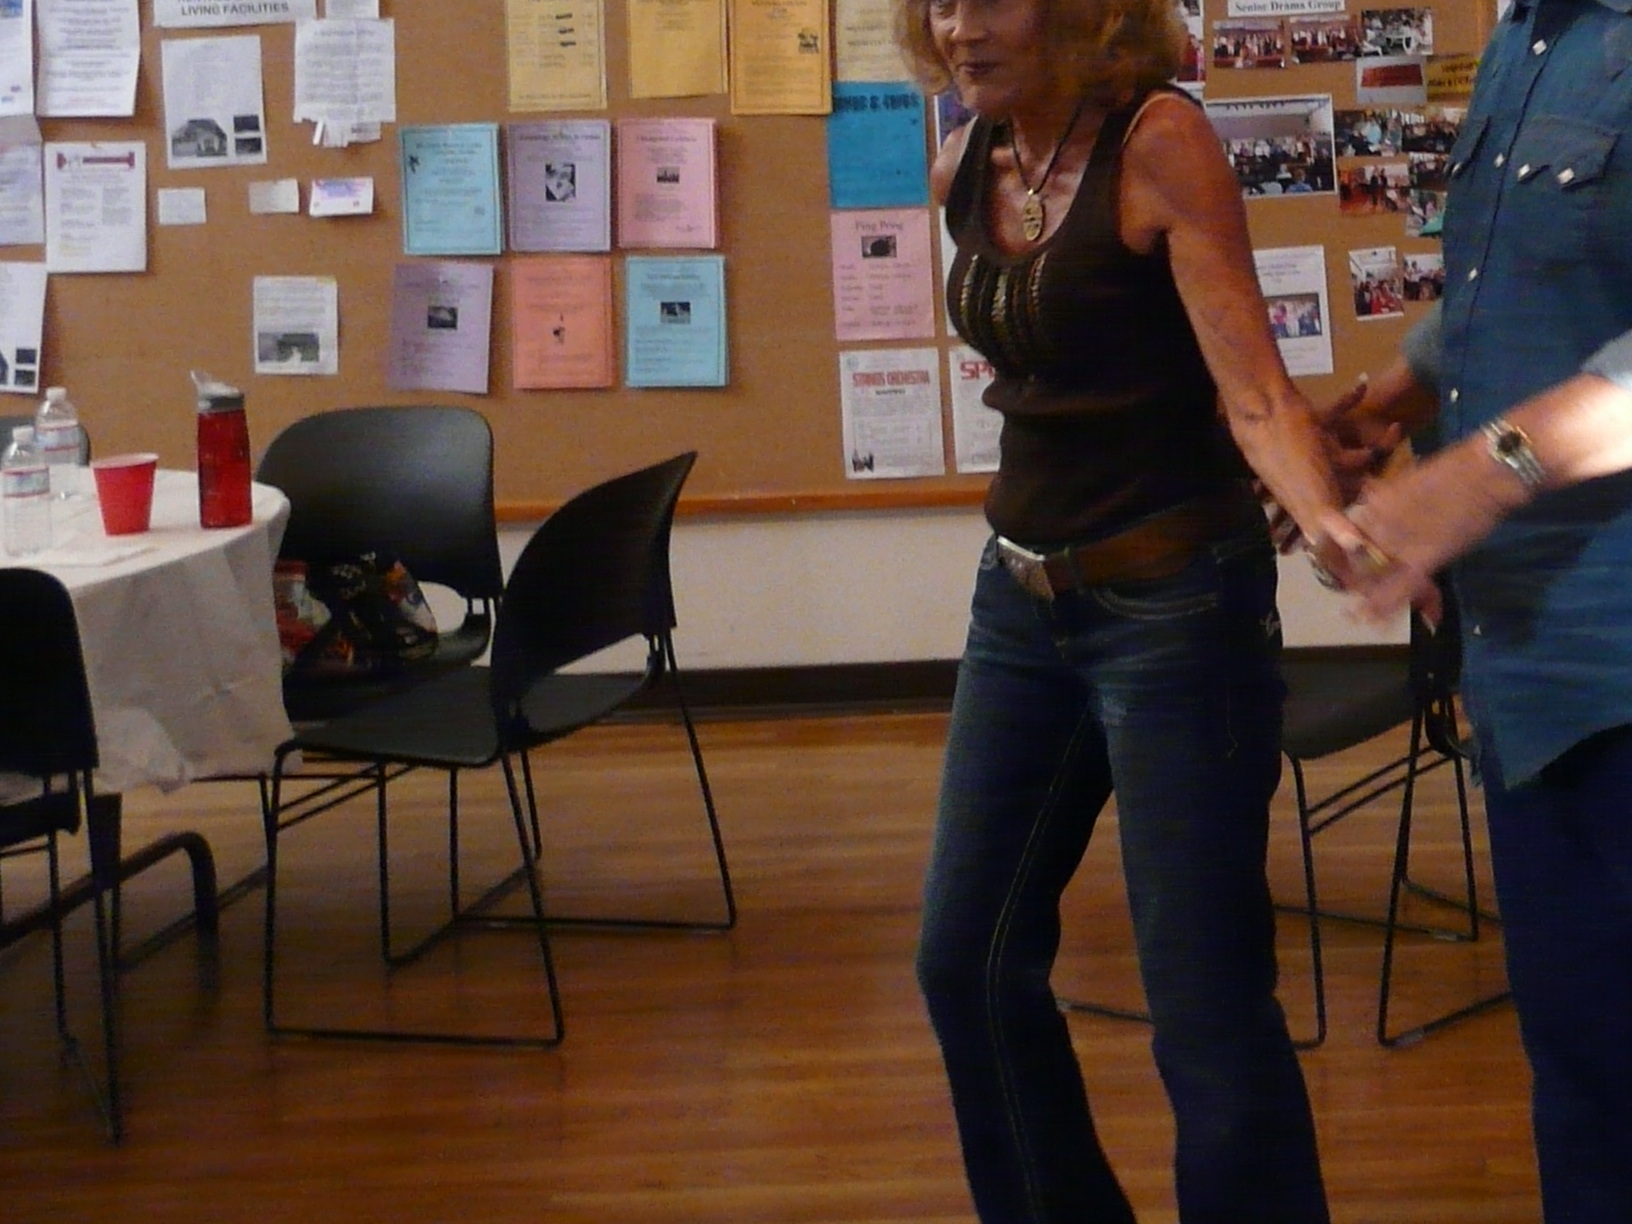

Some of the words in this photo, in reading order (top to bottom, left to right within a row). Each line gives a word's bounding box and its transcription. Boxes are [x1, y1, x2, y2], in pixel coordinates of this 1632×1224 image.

[181, 4, 219, 17] LIVING
[223, 3, 289, 15] FACILITIES
[1235, 2, 1267, 13] Senior
[1271, 0, 1306, 11] Drama
[1308, 0, 1341, 12] Group
